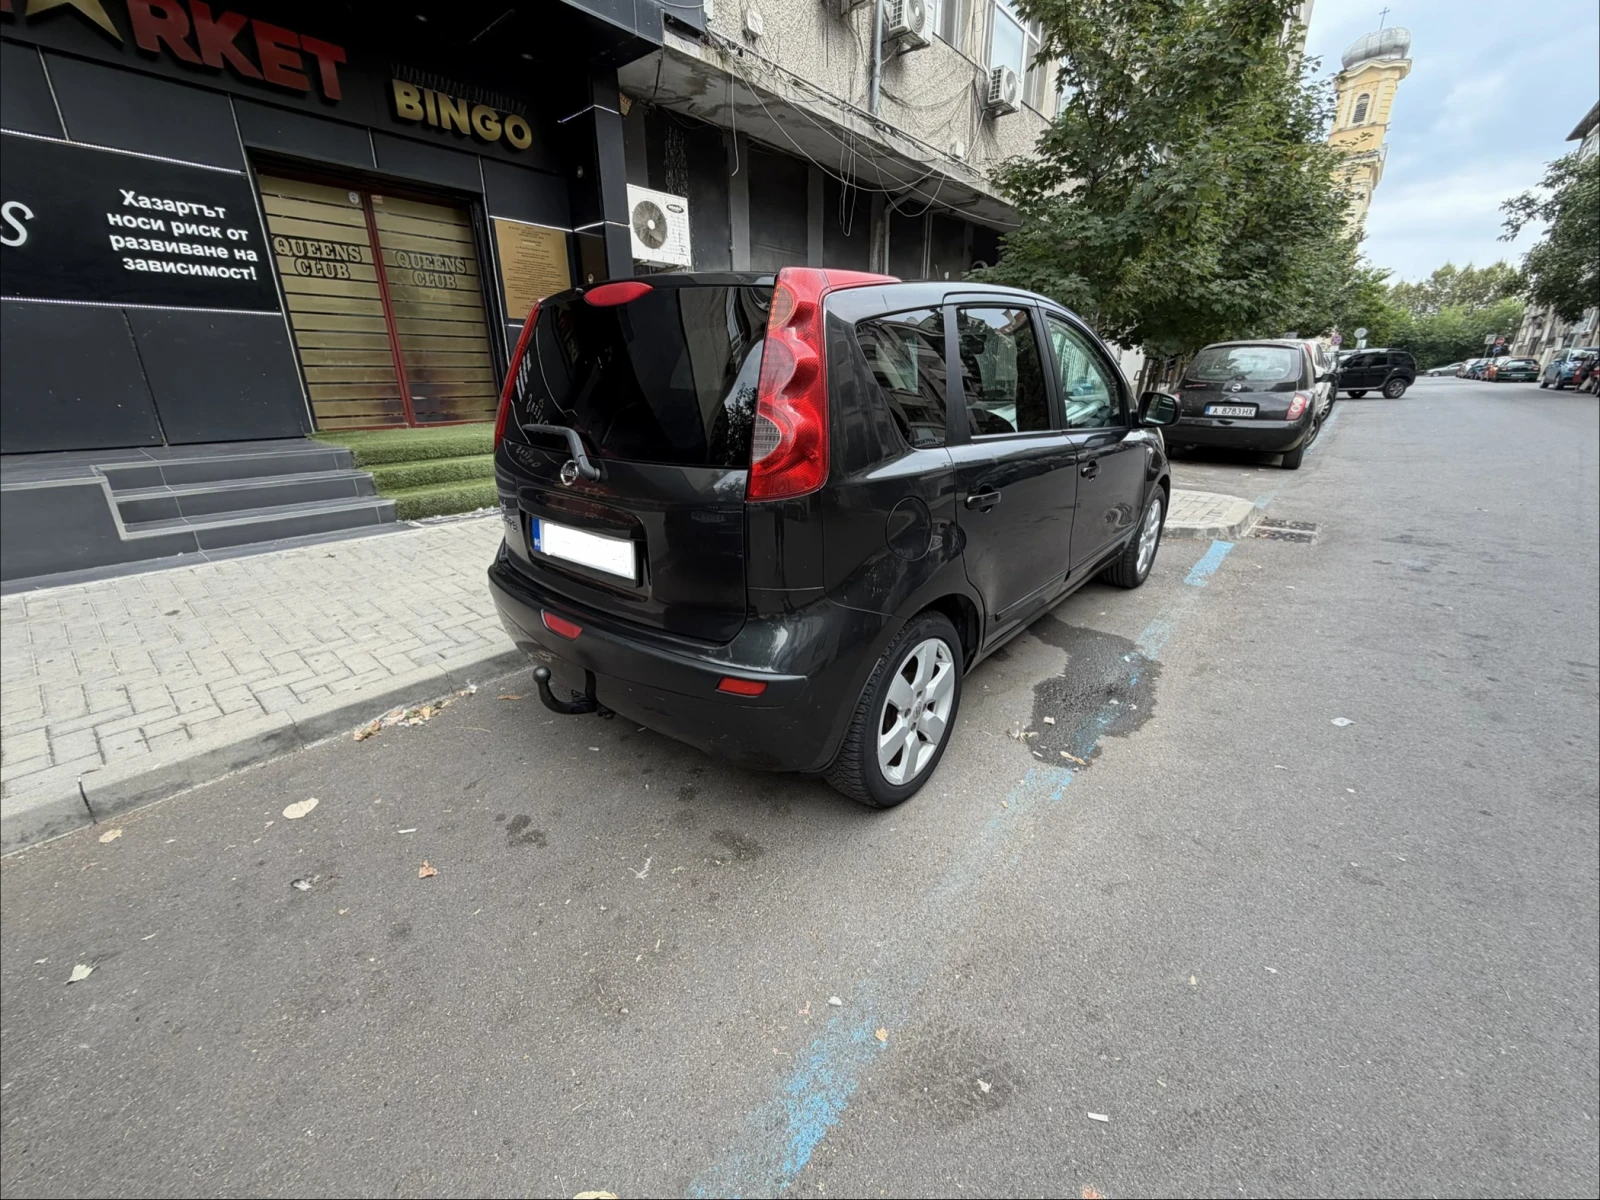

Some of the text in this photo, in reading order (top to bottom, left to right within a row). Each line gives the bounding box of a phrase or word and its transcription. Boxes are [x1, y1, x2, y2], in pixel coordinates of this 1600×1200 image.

[392, 79, 533, 149] BINGO
[119, 188, 226, 219] Хазартът
[106, 212, 249, 241] носи риск от
[109, 234, 259, 262] развиване на
[273, 236, 362, 263] QUEENS
[122, 257, 257, 281] зависимост!
[295, 258, 350, 279] CLUB
[395, 250, 467, 274] QUEENS
[412, 270, 457, 289] CLUB
